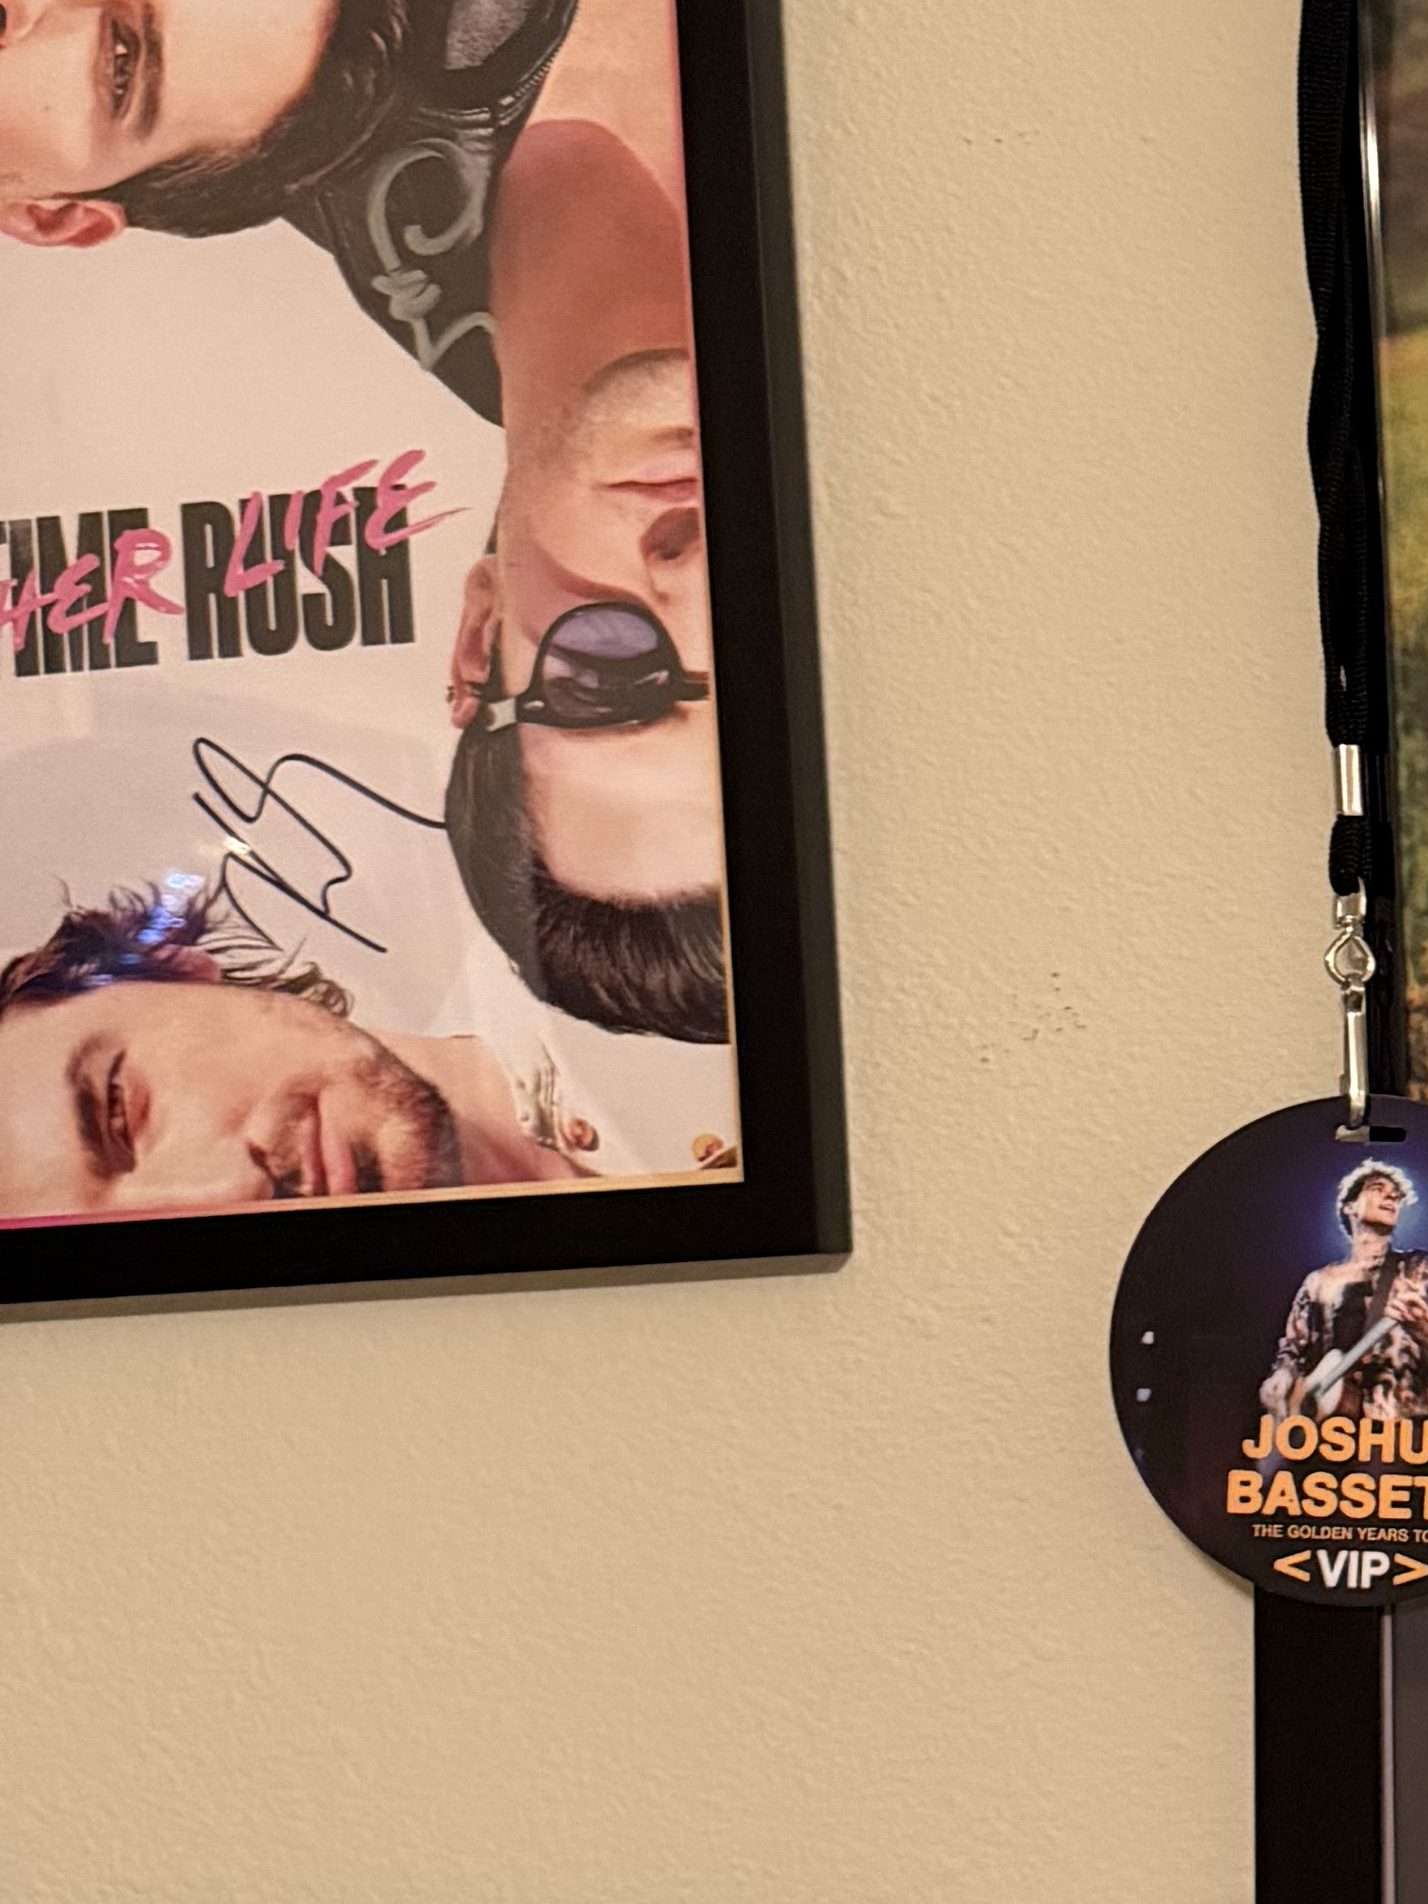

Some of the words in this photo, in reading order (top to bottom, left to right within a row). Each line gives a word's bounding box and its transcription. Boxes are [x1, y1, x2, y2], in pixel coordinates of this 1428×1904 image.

[0, 508, 159, 678] IME
[224, 449, 471, 597] LIFE
[1252, 1524, 1283, 1539] THE
[1287, 1525, 1353, 1541] GOLDEN
[1357, 1527, 1409, 1542] YEARS
